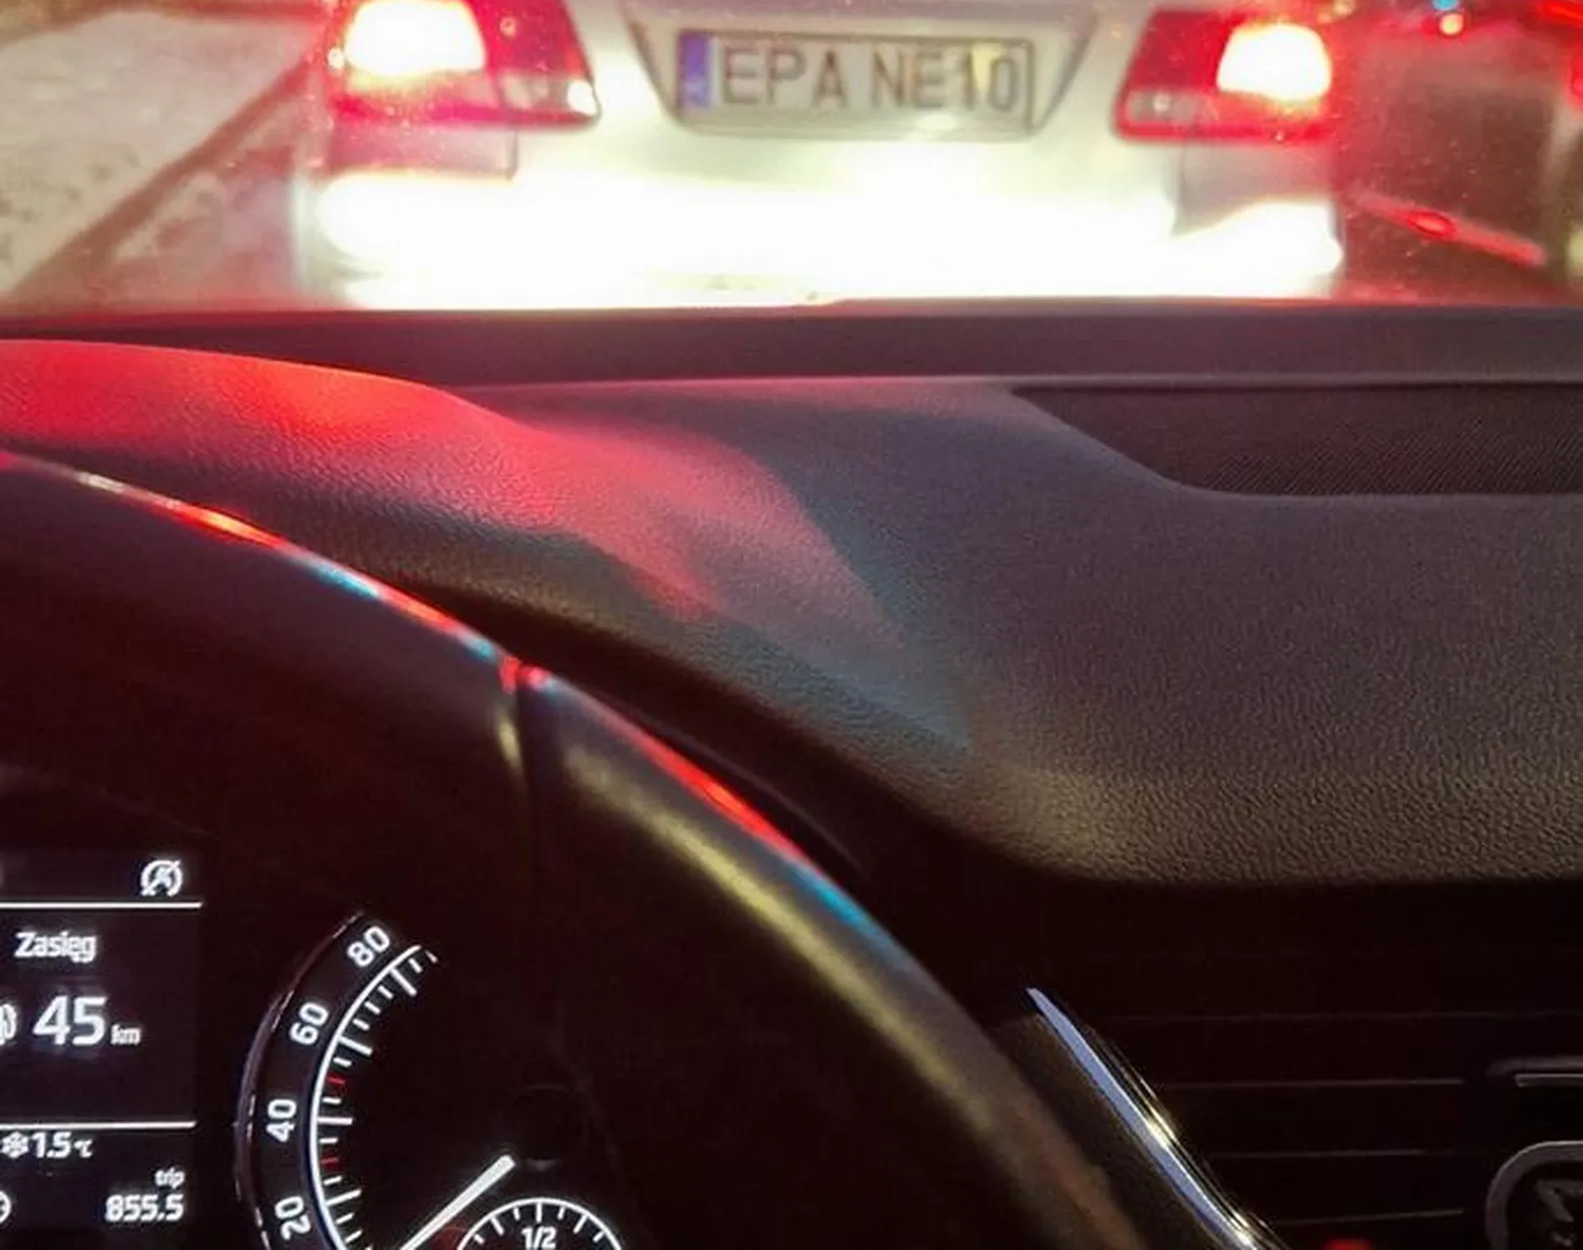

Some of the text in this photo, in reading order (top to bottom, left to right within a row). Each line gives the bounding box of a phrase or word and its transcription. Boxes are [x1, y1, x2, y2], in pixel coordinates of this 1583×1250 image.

[723, 47, 848, 109] EPA
[14, 930, 97, 963] Zasięg
[347, 925, 390, 967] 80
[32, 995, 142, 1045] 45 km
[289, 1002, 329, 1045] 60
[266, 1099, 297, 1142] 40
[154, 1166, 186, 1189] trip
[104, 1193, 184, 1222] 855.5
[274, 1196, 312, 1240] 20
[521, 1226, 557, 1250] 1/2
